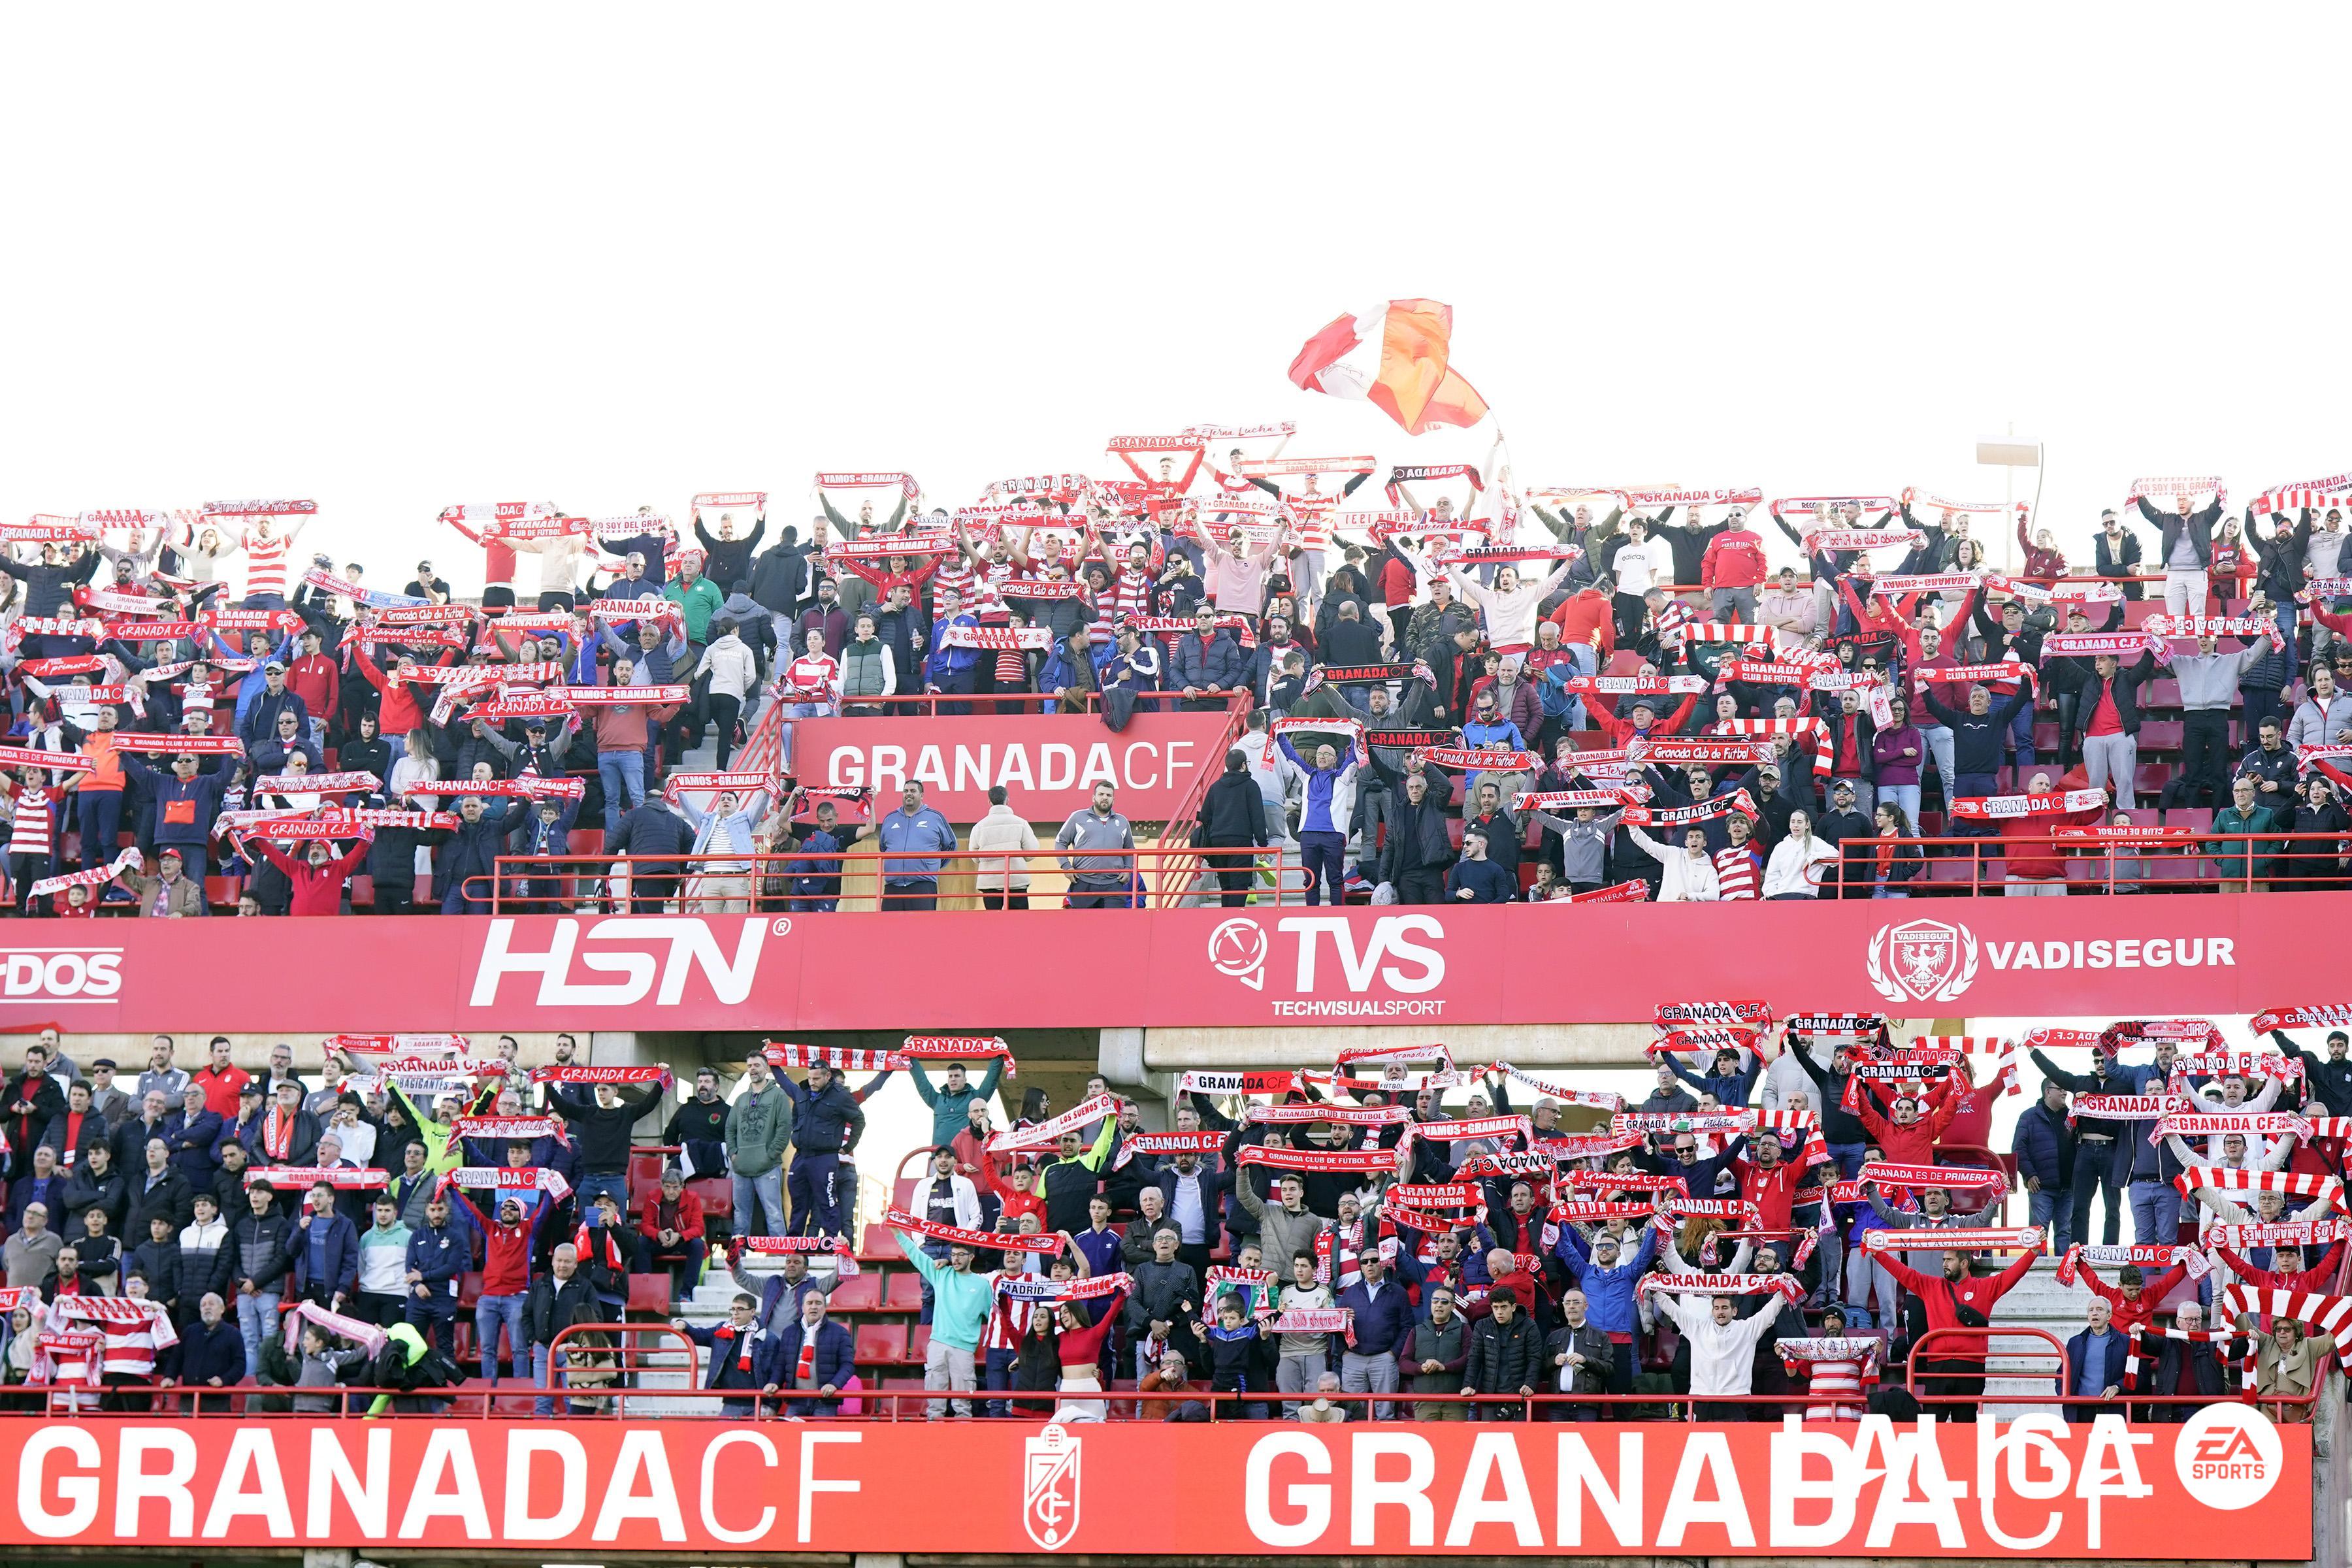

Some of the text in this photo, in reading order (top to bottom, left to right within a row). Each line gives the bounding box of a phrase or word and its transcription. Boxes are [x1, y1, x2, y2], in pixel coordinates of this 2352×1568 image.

[1109, 436, 1204, 448] GRANADA C.F.
[999, 475, 1079, 491] GRANADA CF
[2137, 483, 2149, 492] YO
[2153, 483, 2170, 492] SOY
[2172, 482, 2187, 491] DEL
[1644, 491, 1710, 502] GRANADA
[1213, 500, 1265, 510] GRANADA C.F.
[88, 514, 139, 523] GRANADA
[509, 519, 562, 529] GRANADA
[1, 528, 75, 539] GRANADA C.F.
[1466, 547, 1526, 558] GRANADA
[1622, 553, 1645, 562] adidas
[2311, 580, 2351, 589] GRANADA
[216, 611, 270, 619] GRANADA
[964, 632, 1029, 642] GRANADA CF
[2061, 636, 2140, 650] GRANADA C.F.
[1328, 666, 1409, 679] GRANADA CF
[1741, 664, 1803, 675] GRANADA
[1946, 671, 1965, 680] CLUB
[1967, 670, 1978, 679] DE
[1595, 677, 1675, 690] GRANADA CF
[487, 700, 546, 713] GRANADA
[1370, 732, 1451, 745] GRANADA CF
[1433, 747, 1518, 767] Granada Club de Fútbol
[1654, 745, 1749, 760] Granada Club de Fútbol
[1533, 789, 1622, 802] SEREIS ETERNOS
[1661, 800, 1728, 822] GRANADA CF
[1982, 794, 2074, 815] GRANADA CF
[269, 823, 350, 836] GRANADA C.F.
[46, 868, 108, 888] GRANADA
[1897, 932, 1950, 941] VADISEGUR
[1277, 913, 1446, 994] TVS
[1985, 938, 2236, 970] VADISEGUR
[469, 917, 770, 1007] HSN
[1271, 1000, 1446, 1016] TECHVISUALSPORT
[1662, 1004, 1761, 1019] GRANADA C.F.
[1795, 1018, 1874, 1030] GRANADA CF
[1676, 1031, 1752, 1046] GRANADA C.F.
[861, 1051, 885, 1063] ALONE
[387, 1060, 458, 1072] GRANADA
[1862, 1066, 1938, 1077] GRANADA CF
[561, 1068, 651, 1081] GRANADA C.F.
[1199, 1075, 1286, 1090] GRANADA CF
[2087, 1096, 2159, 1113] GRANADA
[1059, 1113, 1071, 1124] LOS
[1279, 1109, 1315, 1119] GRANADA
[1318, 1109, 1338, 1118] CLUB
[1354, 1109, 1382, 1120] FÚTBOL
[2180, 1113, 2257, 1131] GRANADA
[1136, 1135, 1200, 1149] GRANADA
[1269, 1153, 1303, 1162] GRANADA
[1338, 1155, 1366, 1164] FÚTBOL
[453, 1169, 544, 1186] GRANADA CF
[1867, 1168, 1912, 1179] GRANADA
[1930, 1172, 1942, 1181] DE
[1945, 1172, 1988, 1182] PRIMERA
[826, 1171, 834, 1208] GIVOVA
[1397, 1185, 1465, 1197] GRANADA
[1399, 1195, 1466, 1206] CLUB DE FÚTBOL
[920, 1220, 1022, 1246] Granada C.F.
[1900, 1237, 2007, 1247] MATAGIGANTES
[2080, 1247, 2155, 1262] GRANADA
[1662, 1274, 1741, 1288] GRANADA
[1002, 1282, 1044, 1295] MADRID
